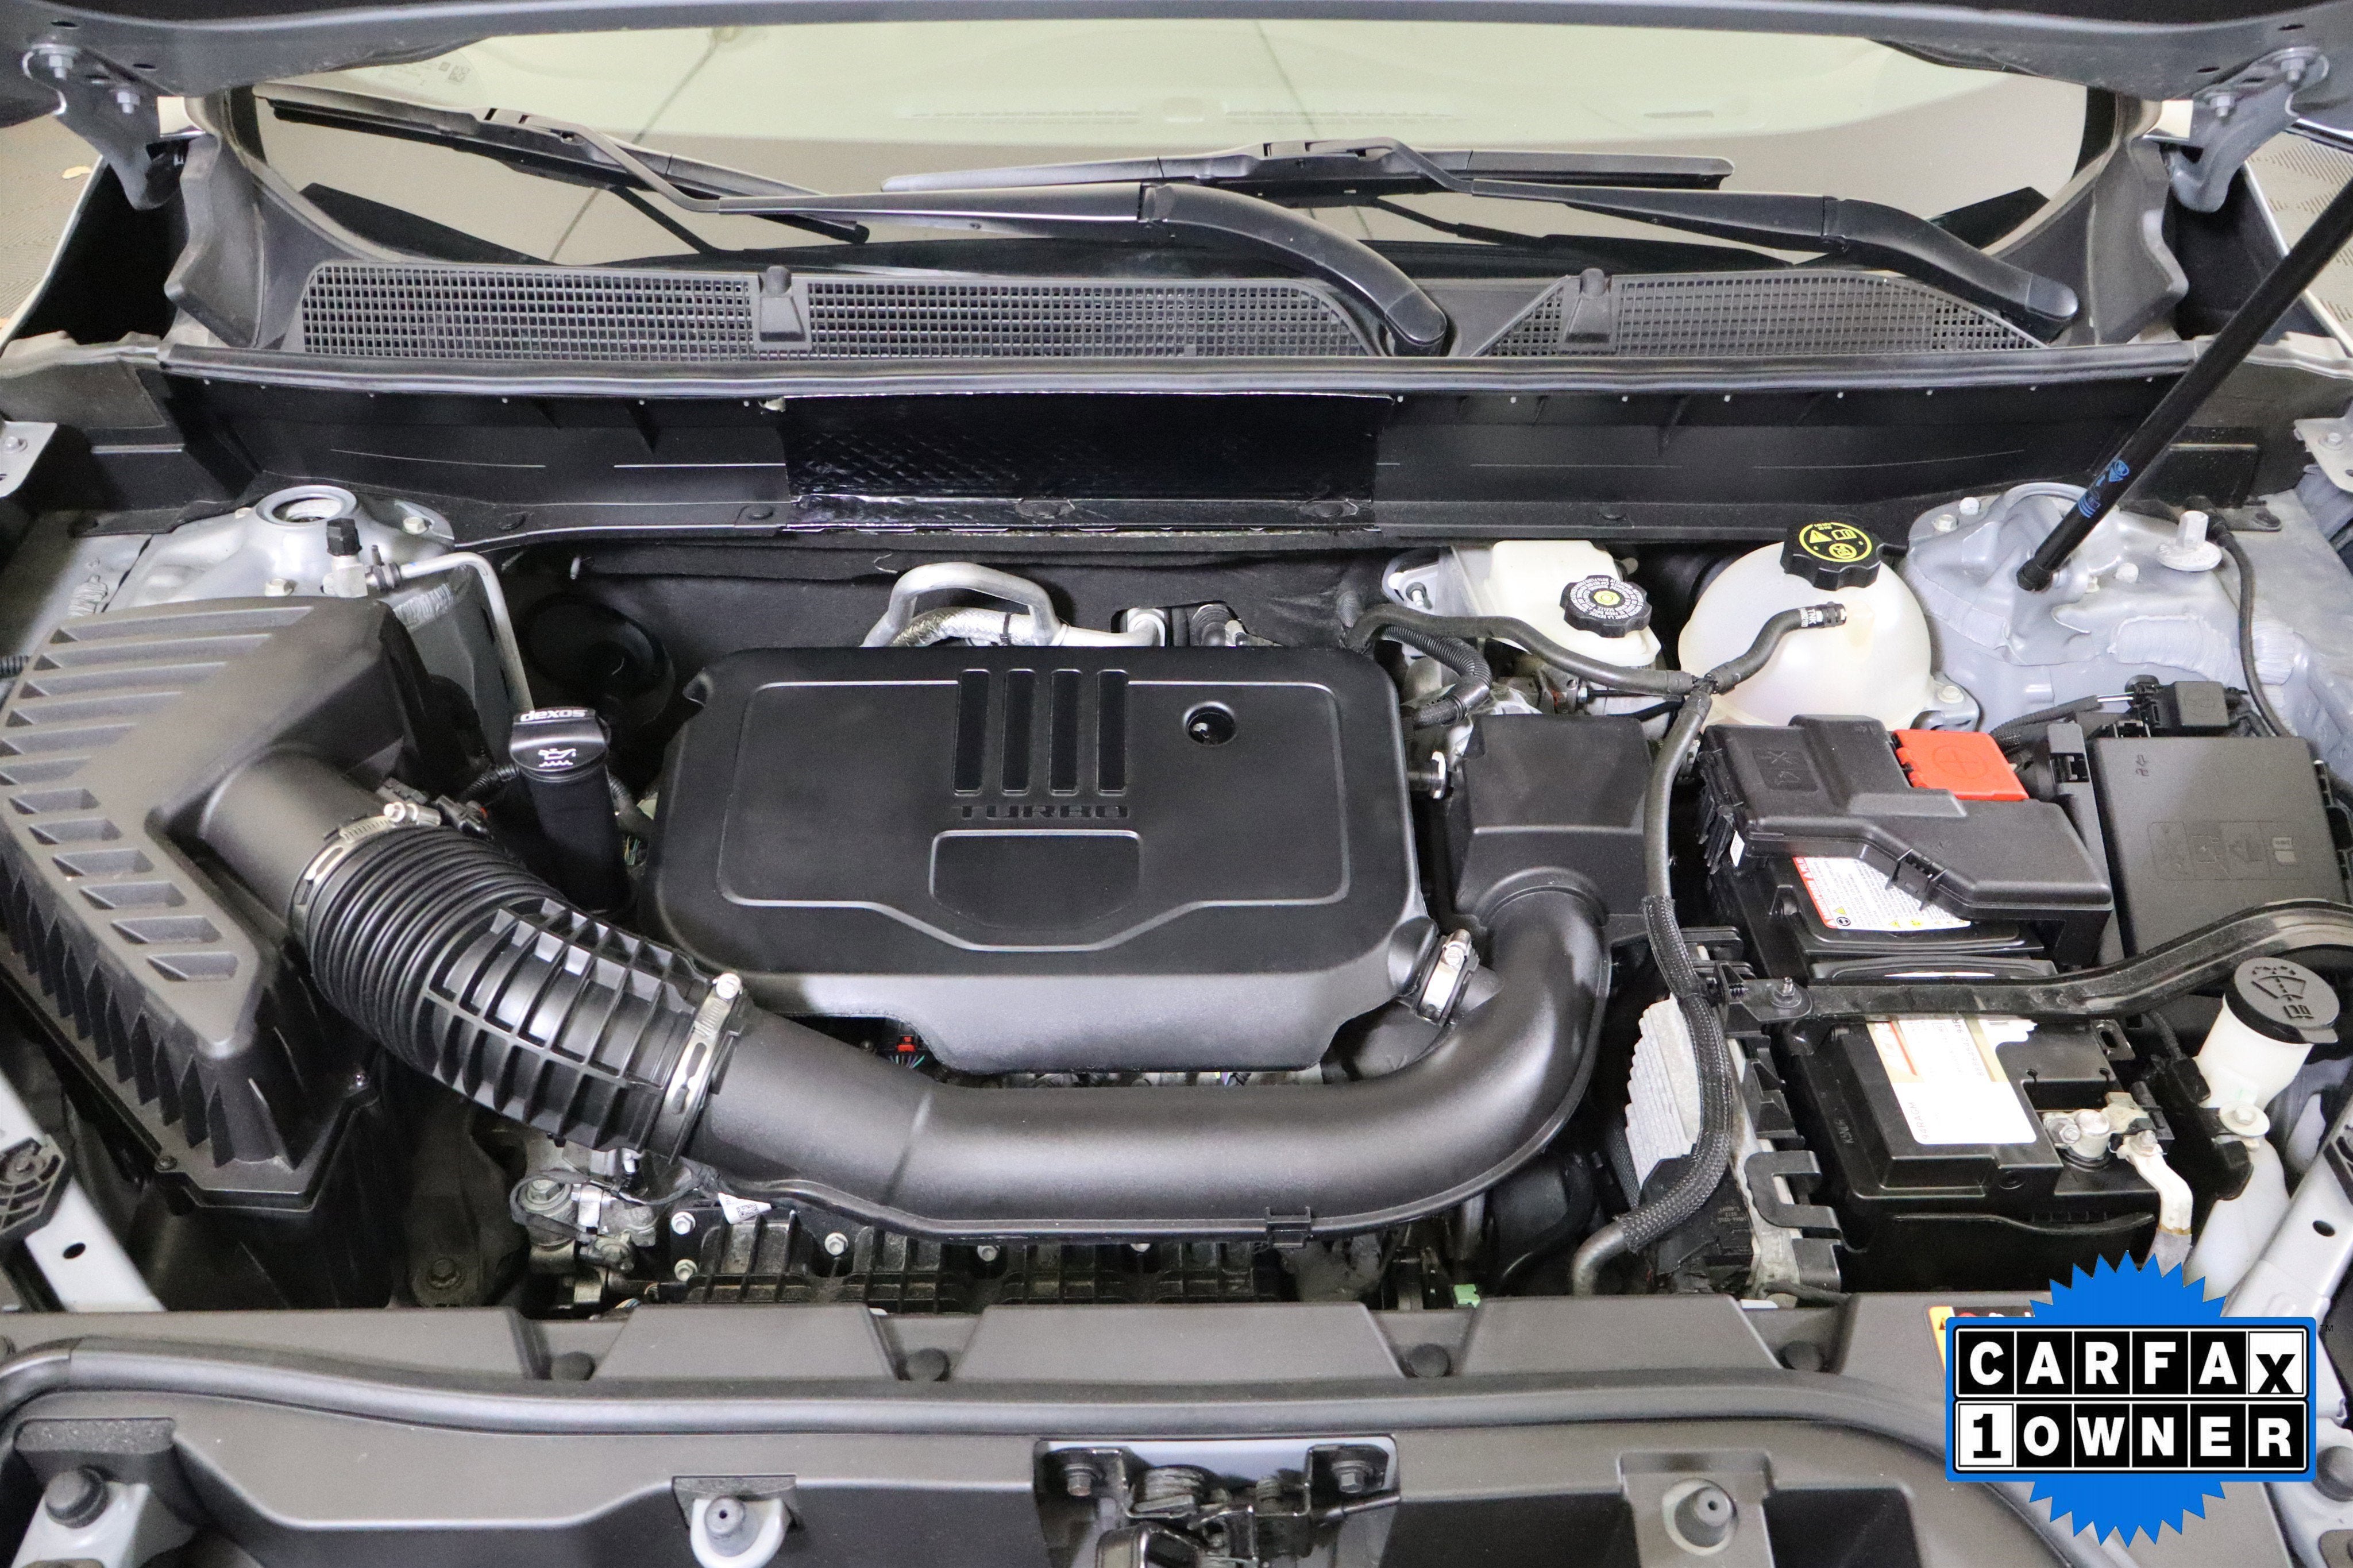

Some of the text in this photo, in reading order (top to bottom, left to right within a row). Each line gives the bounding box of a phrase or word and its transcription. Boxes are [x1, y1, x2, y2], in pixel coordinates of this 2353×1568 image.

[1807, 608, 1816, 624] TNK
[520, 709, 586, 722] dexos
[951, 805, 1129, 820] TURBO
[1908, 1101, 1930, 1140] 94RAGM
